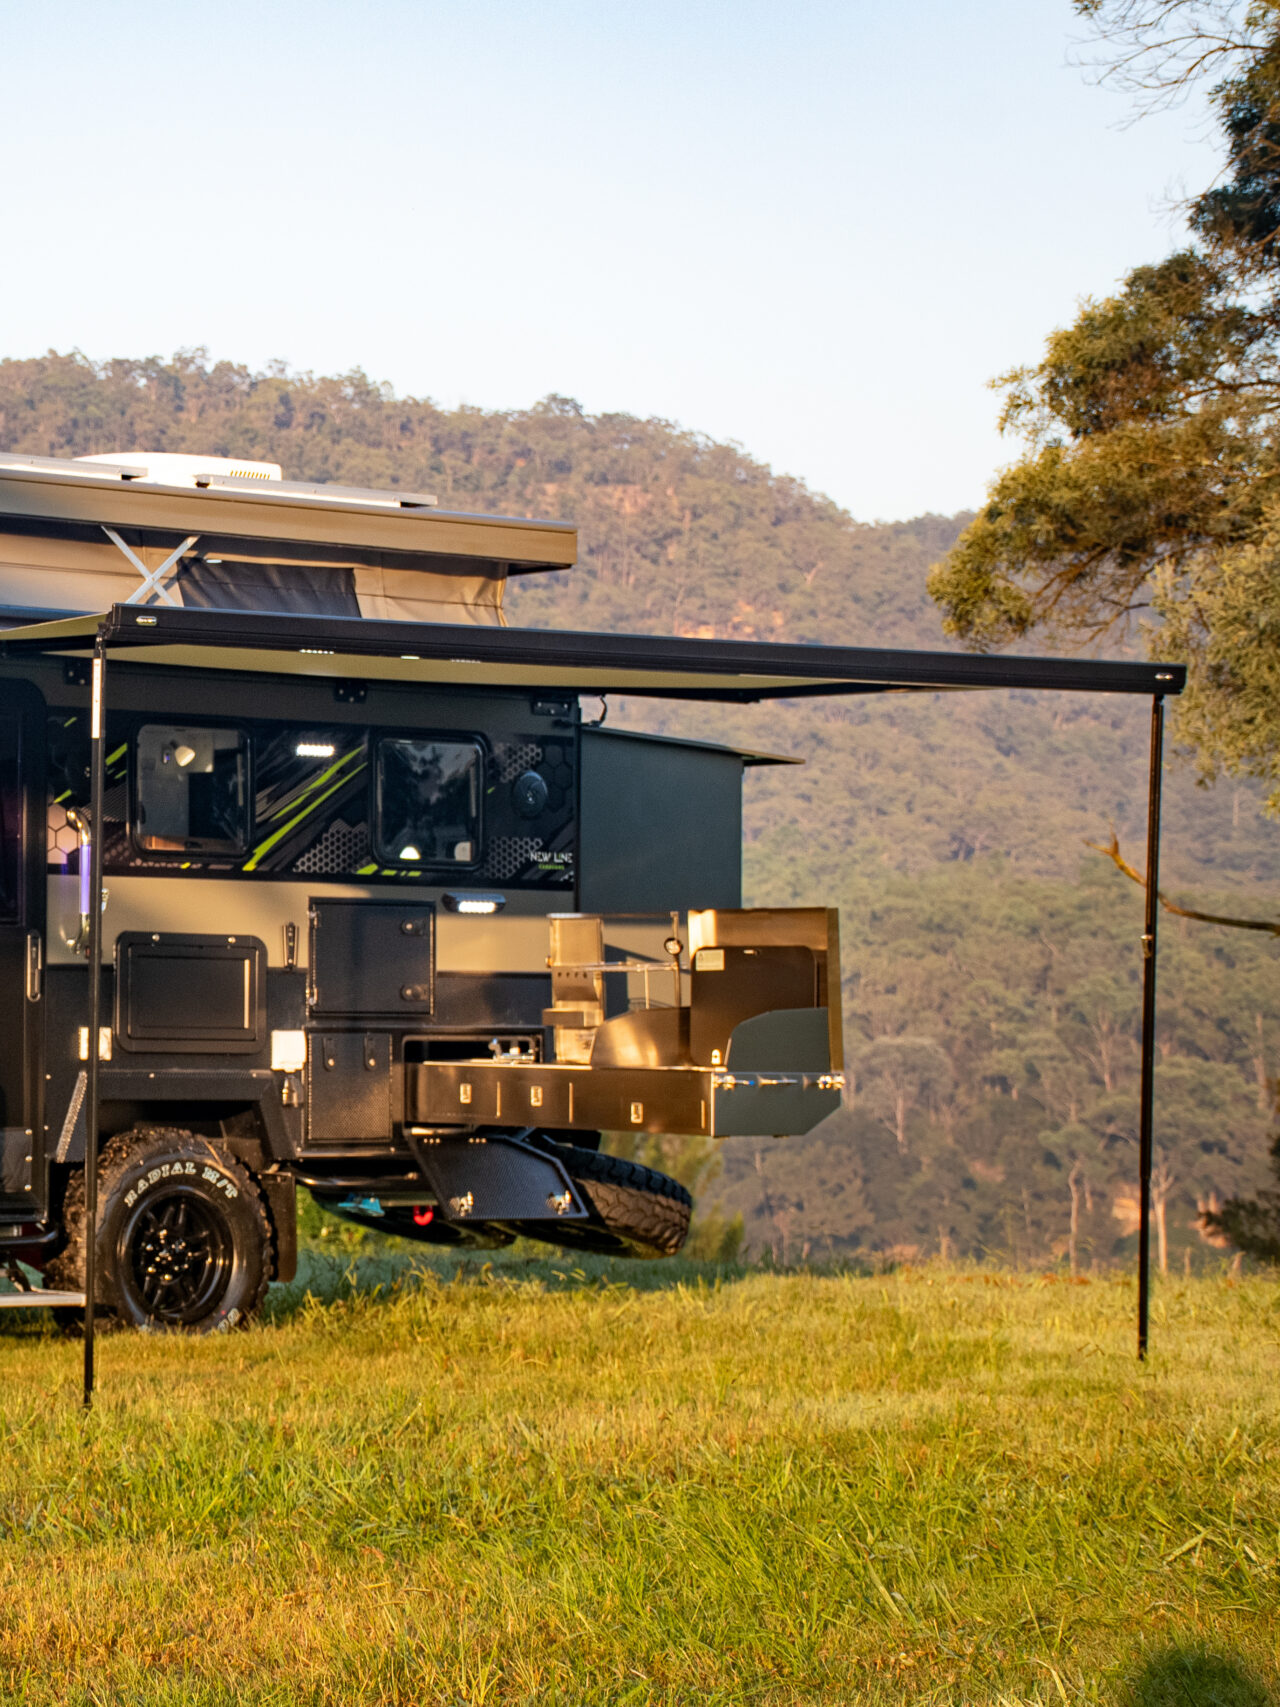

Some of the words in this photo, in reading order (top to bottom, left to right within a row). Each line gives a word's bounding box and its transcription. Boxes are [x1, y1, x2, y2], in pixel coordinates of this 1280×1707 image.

[530, 851, 551, 862] NEW
[553, 851, 573, 863] LINE
[124, 1162, 197, 1208] RADIAL
[202, 1166, 239, 1199] M/T
